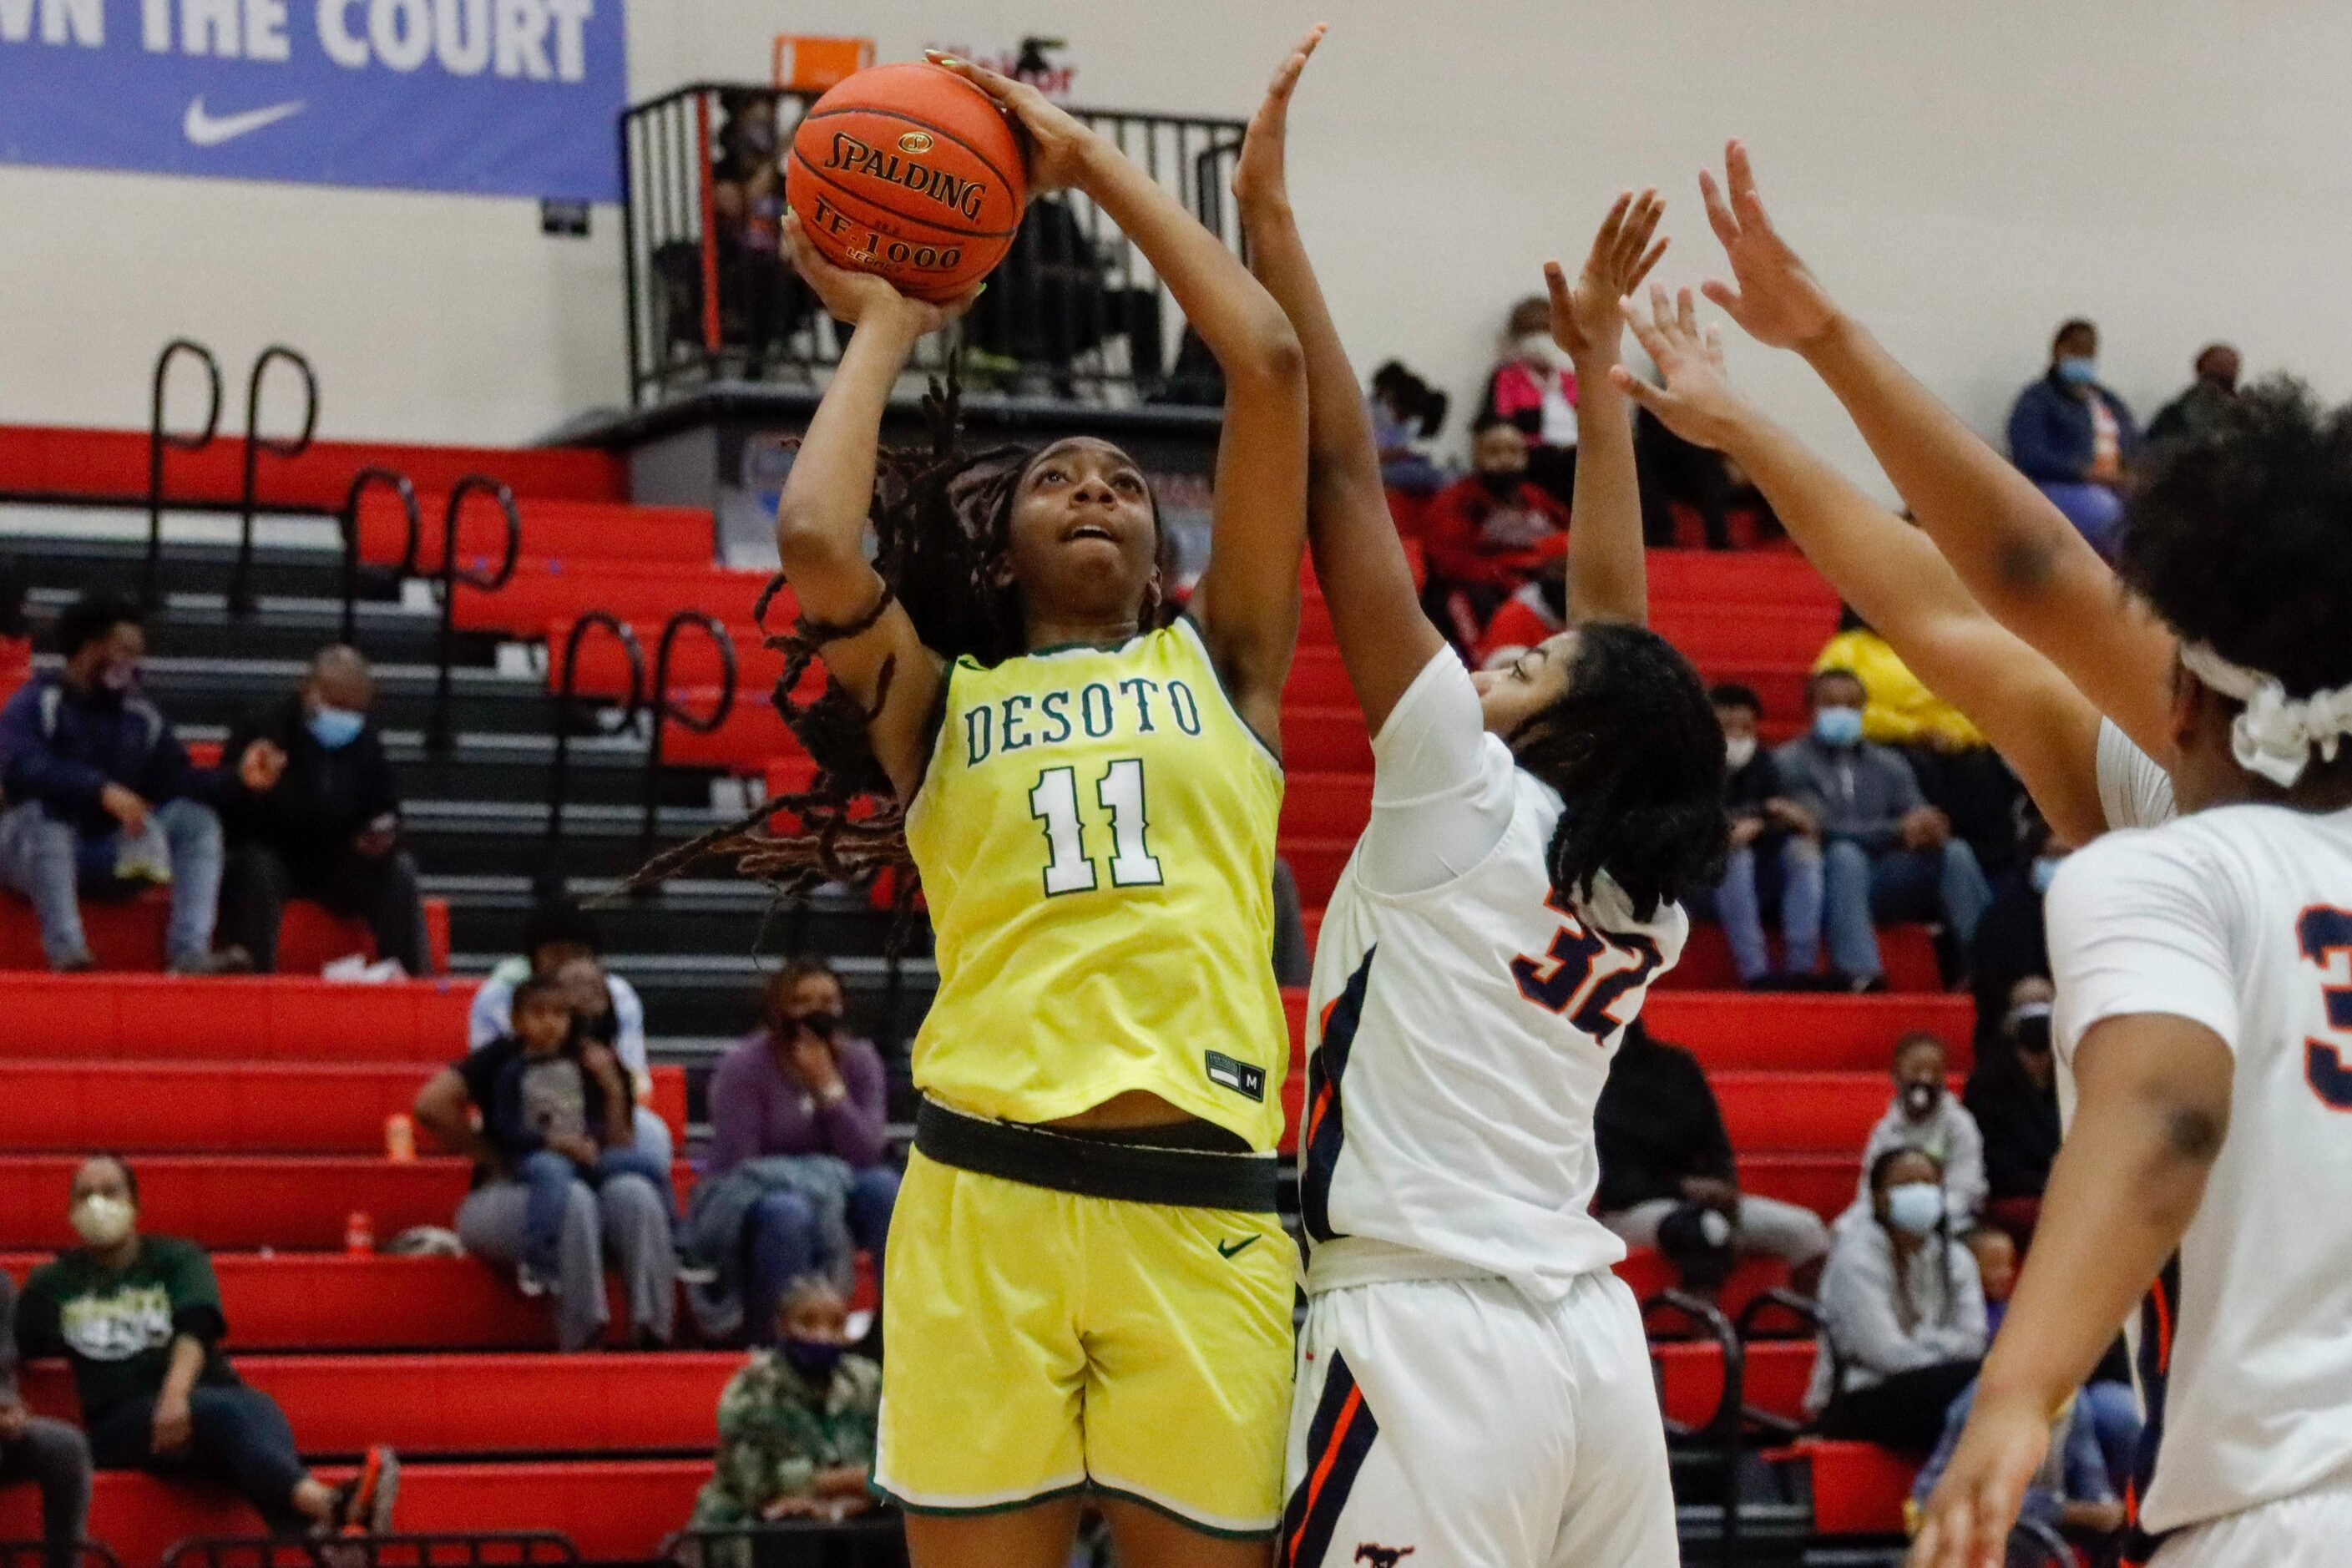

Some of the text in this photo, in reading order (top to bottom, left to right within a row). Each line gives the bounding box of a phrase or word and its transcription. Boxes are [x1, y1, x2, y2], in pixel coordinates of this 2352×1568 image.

[143, 0, 291, 62] THE
[316, 0, 591, 83] COURT
[824, 131, 987, 222] SPALDING
[846, 246, 901, 275] LEG
[964, 677, 1201, 769] DESOTO
[1028, 757, 1165, 898] 11
[1509, 884, 1664, 1047] 32
[1246, 1073, 1258, 1090] M
